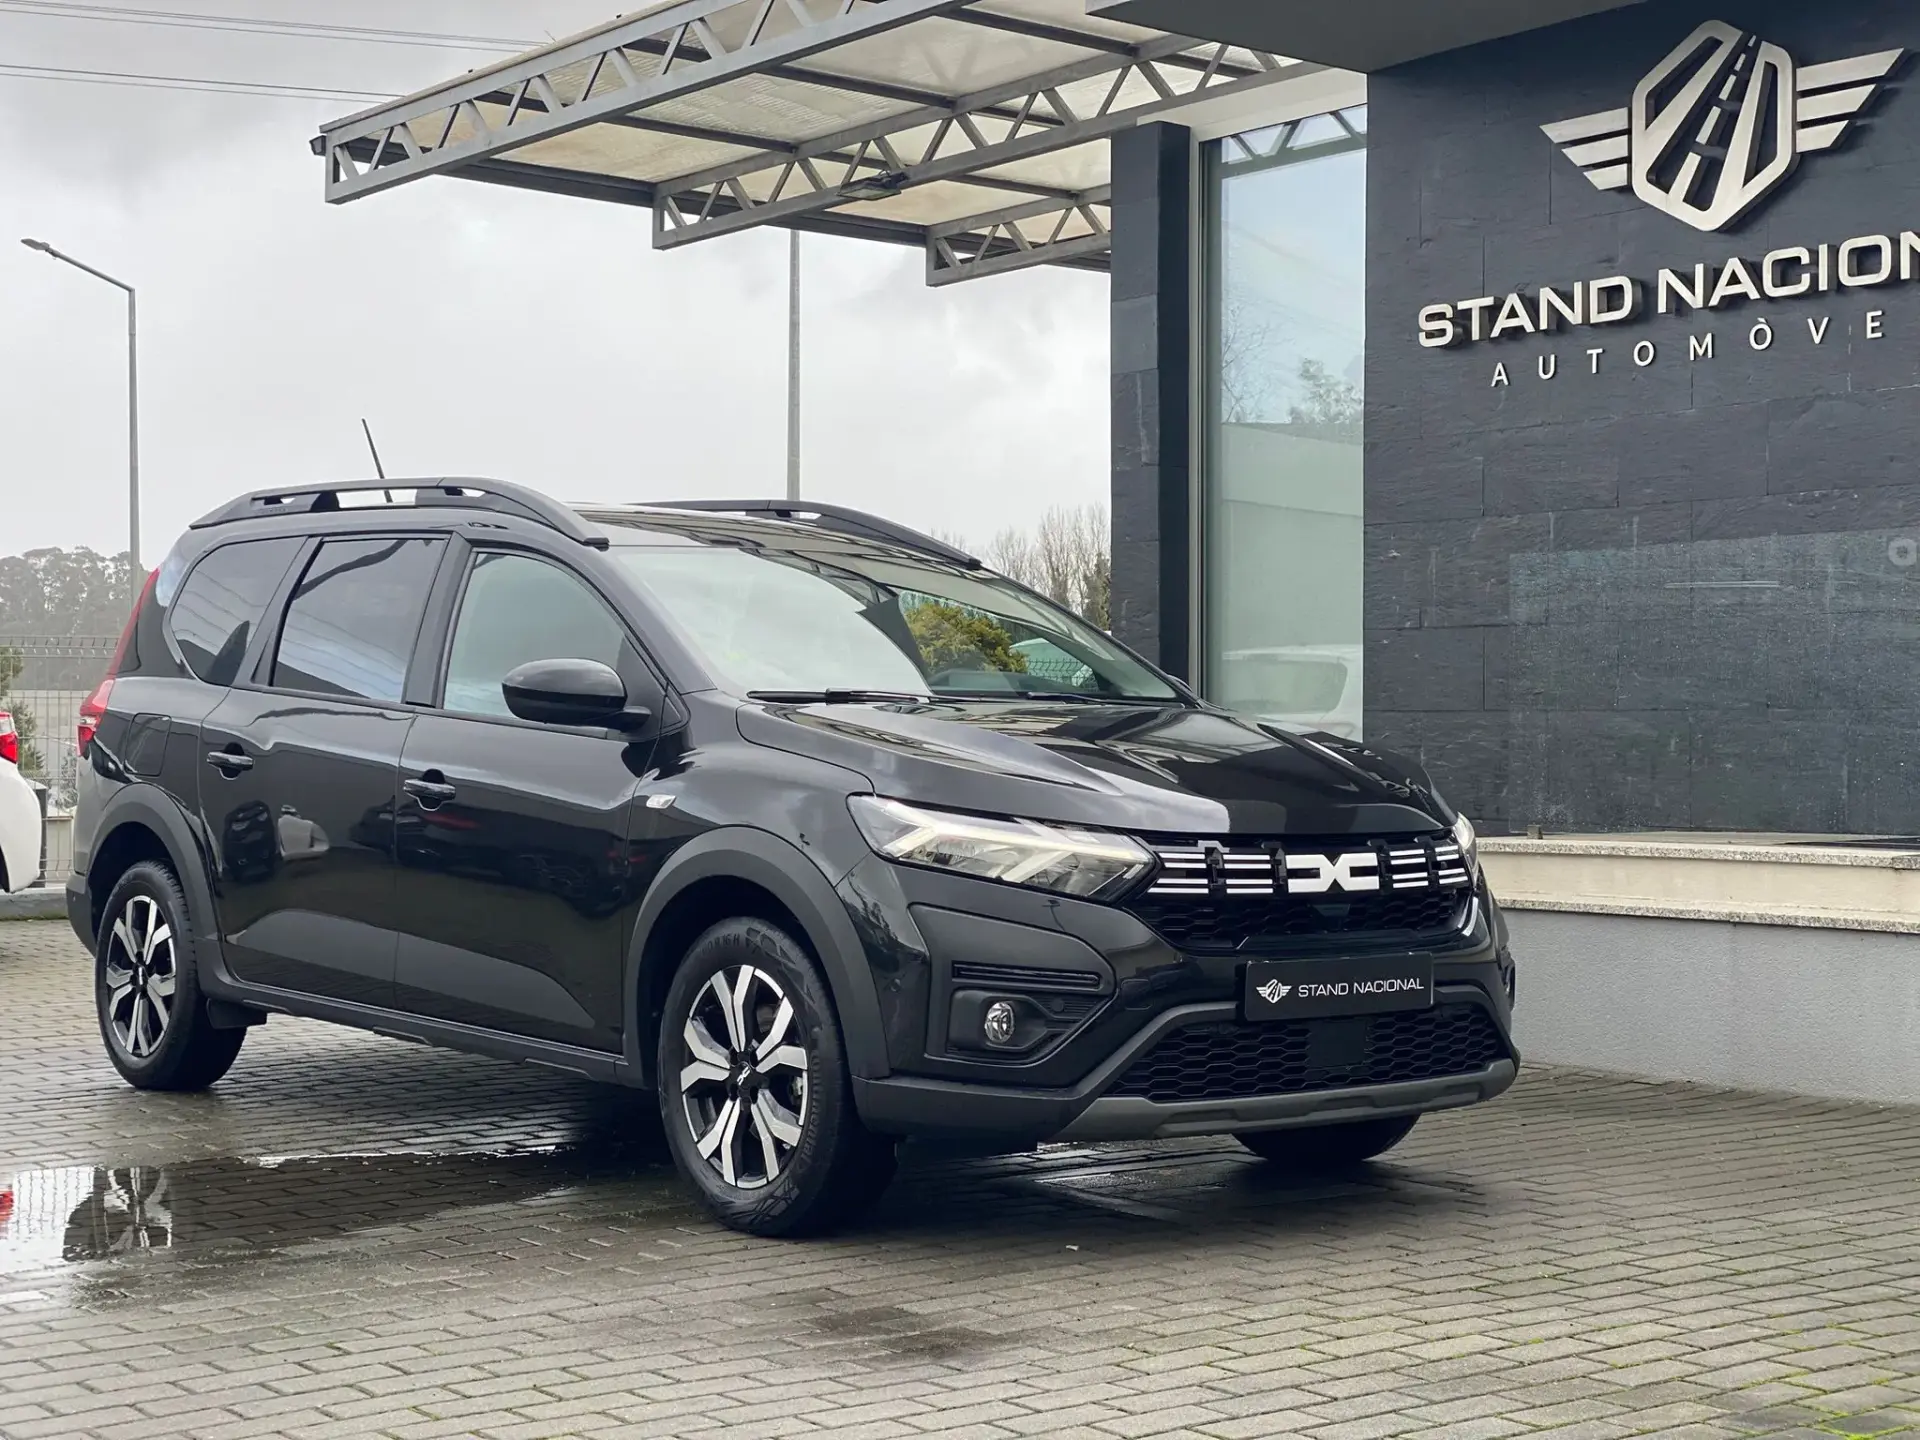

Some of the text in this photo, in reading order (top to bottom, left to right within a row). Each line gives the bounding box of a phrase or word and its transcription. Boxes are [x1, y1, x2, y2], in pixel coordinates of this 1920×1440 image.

[1418, 275, 1636, 348] STAND
[1298, 977, 1425, 998] STAND NACIONAL
